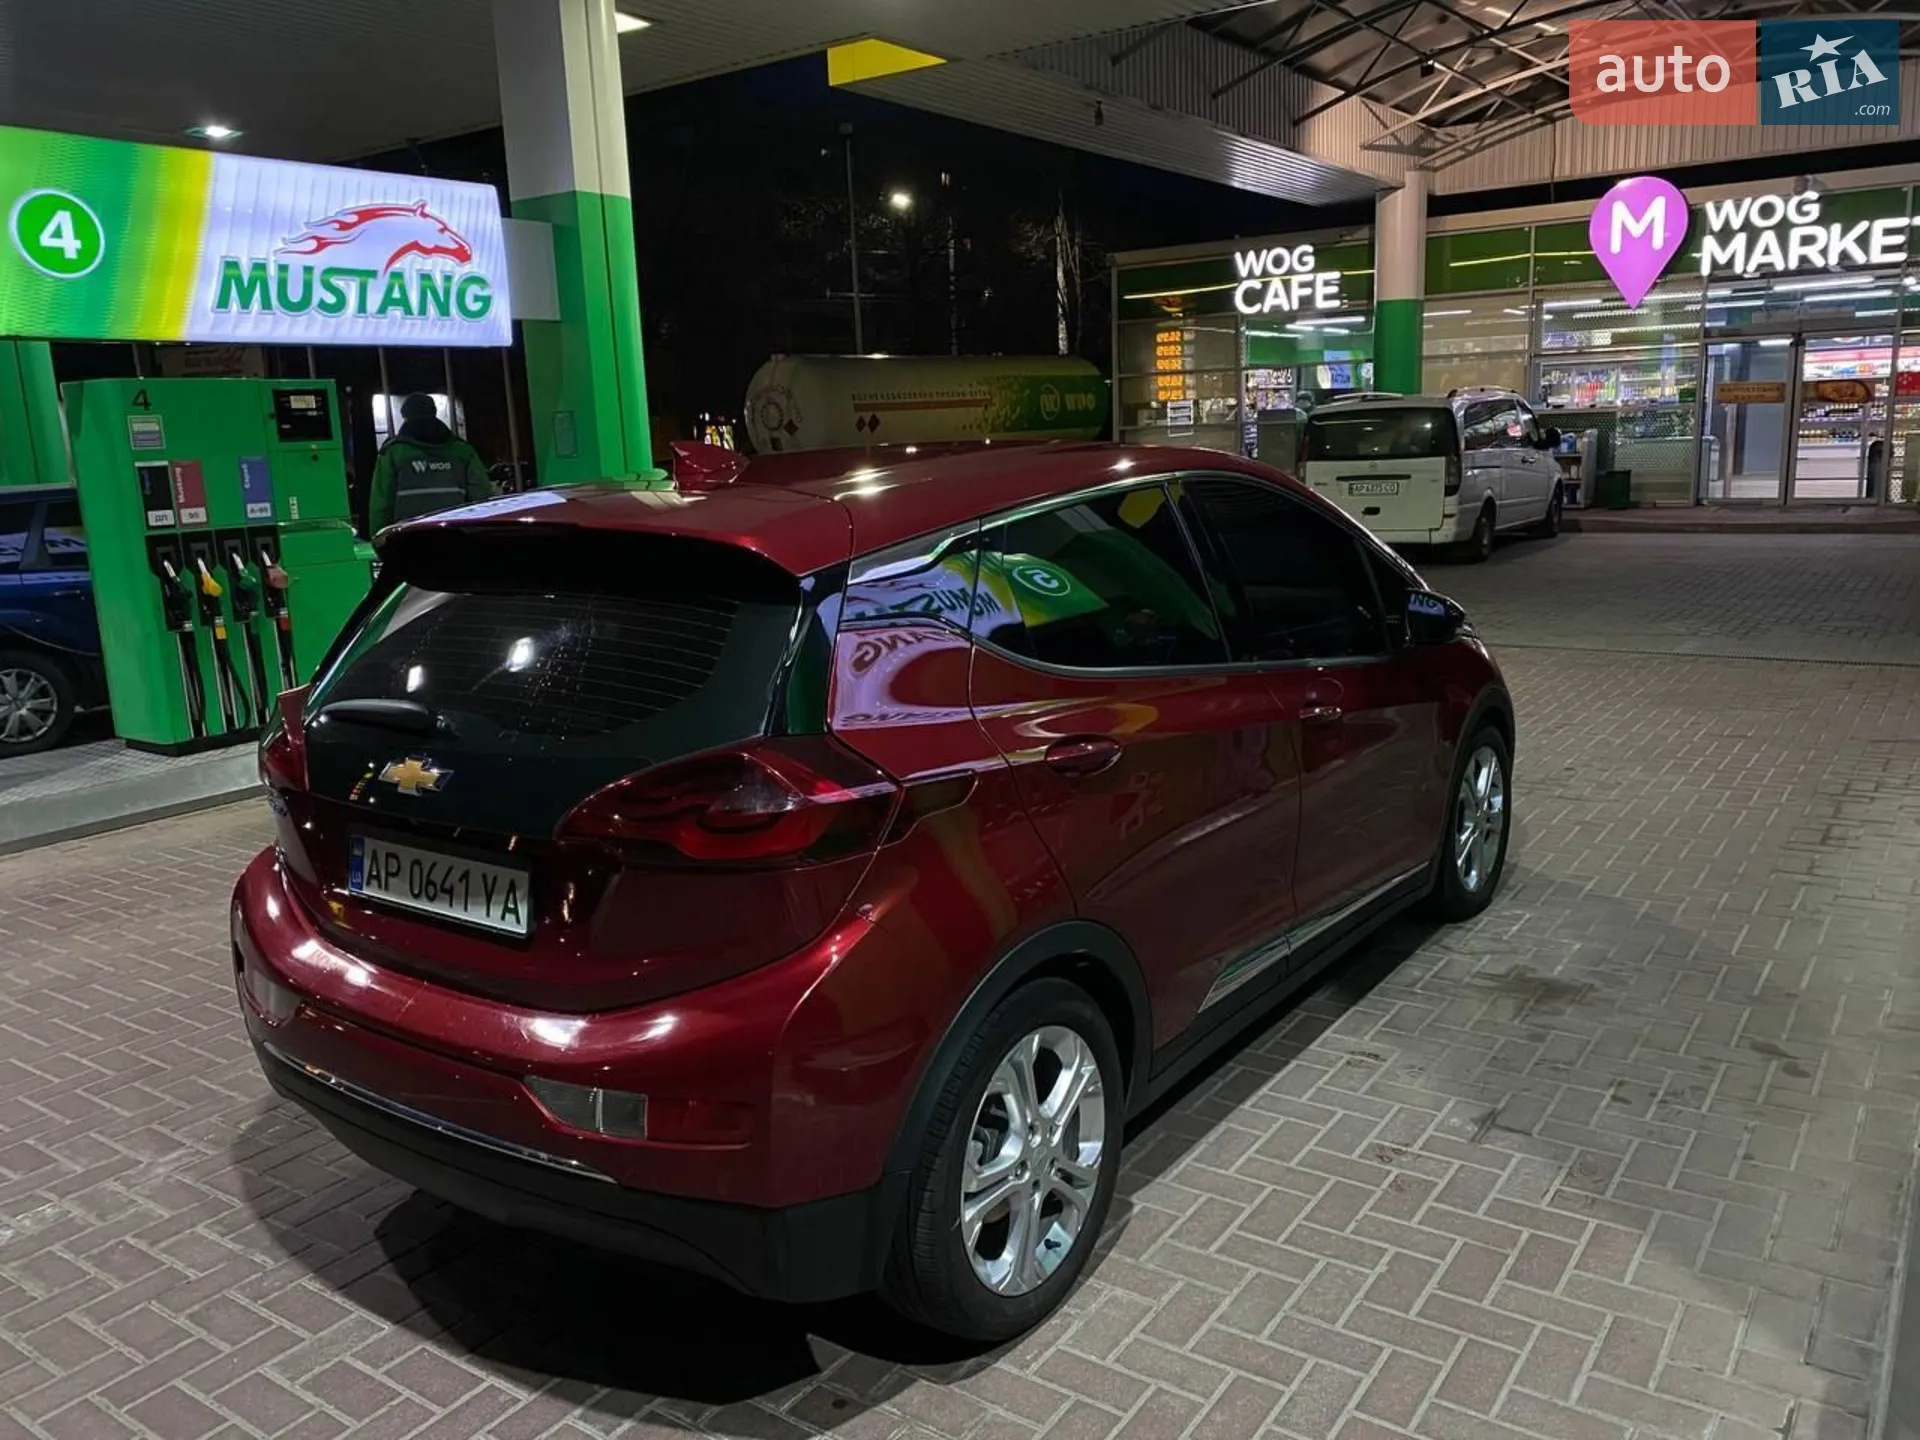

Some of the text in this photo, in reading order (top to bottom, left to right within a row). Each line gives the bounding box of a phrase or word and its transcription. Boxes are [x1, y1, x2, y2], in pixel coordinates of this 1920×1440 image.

[39, 209, 82, 260] 4
[1610, 196, 1666, 254] M
[1705, 191, 1820, 232] WOG
[1234, 244, 1315, 278] WOG
[1701, 215, 1920, 276] MARKE
[213, 257, 493, 321] MUSTANG
[1234, 271, 1341, 314] CAFE
[132, 388, 151, 411] 4
[365, 848, 522, 925] AP 0641 YA
